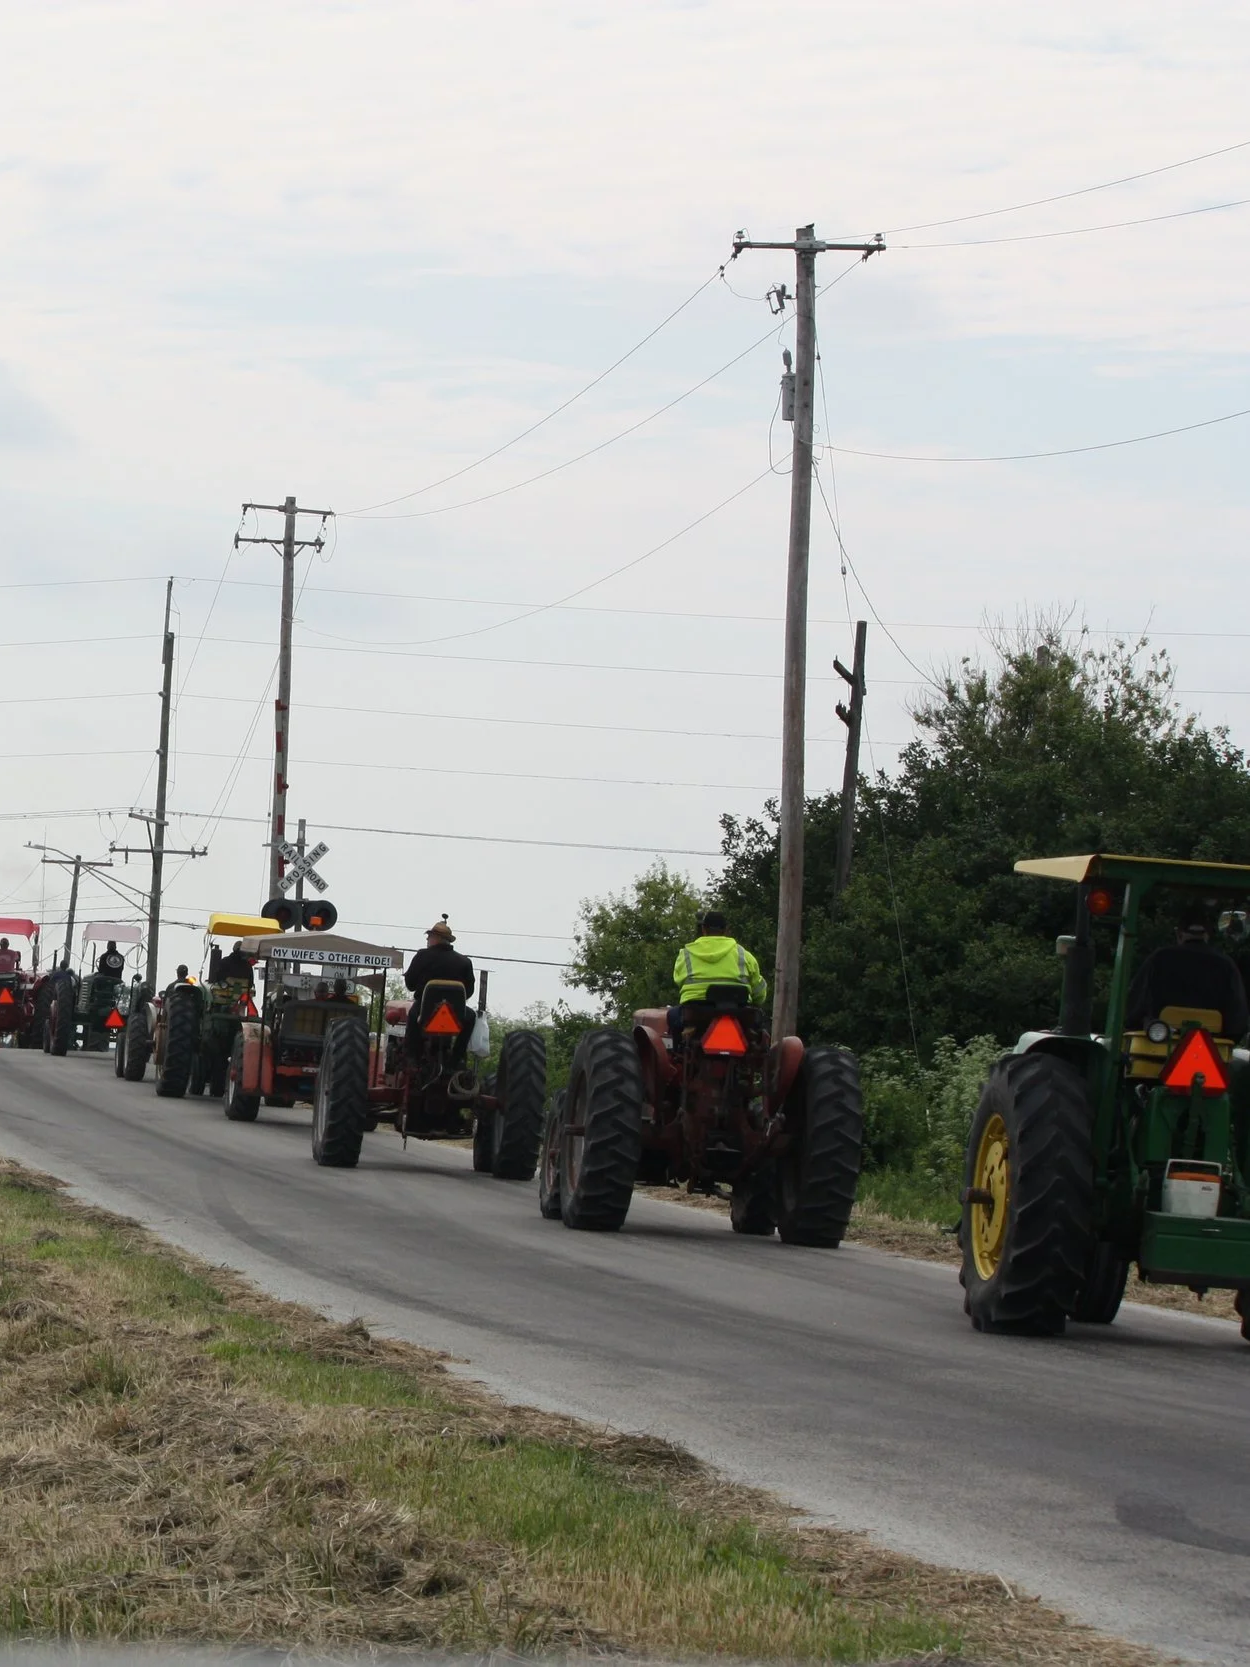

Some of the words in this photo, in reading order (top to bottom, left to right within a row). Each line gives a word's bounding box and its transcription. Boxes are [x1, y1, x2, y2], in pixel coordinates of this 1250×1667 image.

[280, 844, 327, 890] CROSSING
[273, 948, 288, 958] MY
[291, 950, 325, 961] WIFE'S
[328, 953, 361, 964] OTHER
[364, 956, 390, 966] RIDE!
